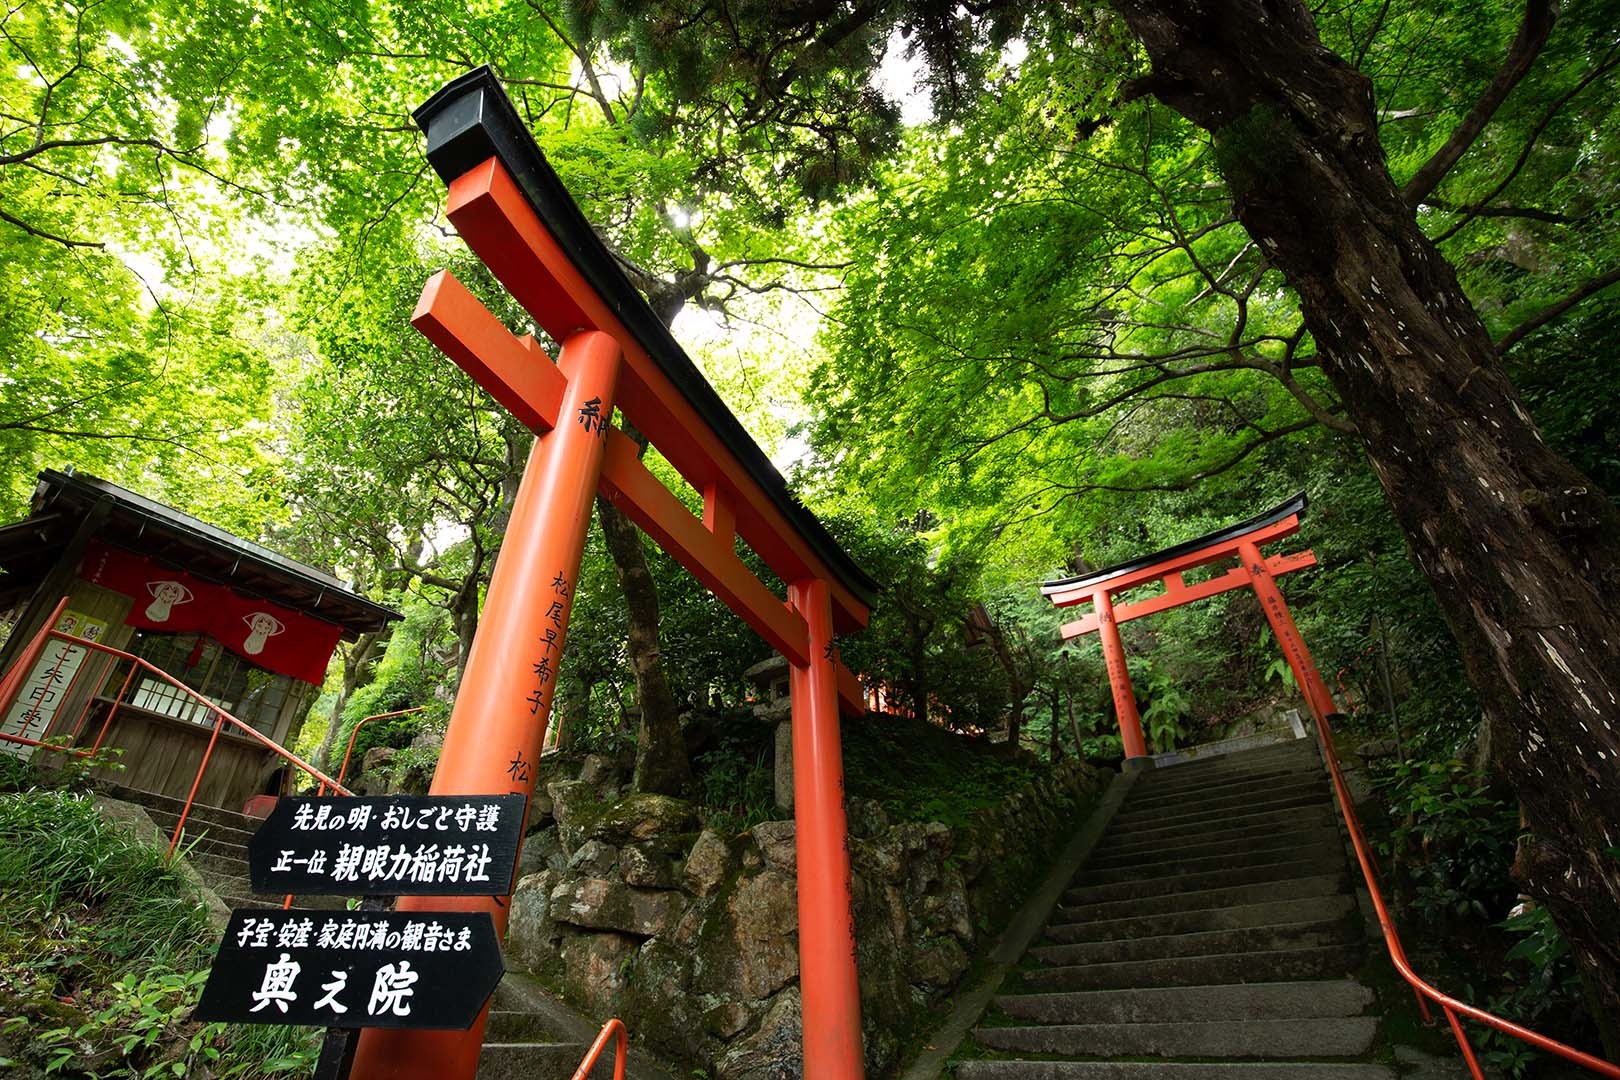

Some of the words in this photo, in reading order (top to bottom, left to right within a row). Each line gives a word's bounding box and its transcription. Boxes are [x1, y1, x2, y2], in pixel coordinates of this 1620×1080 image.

[526, 570, 571, 715] 松尾早希子
